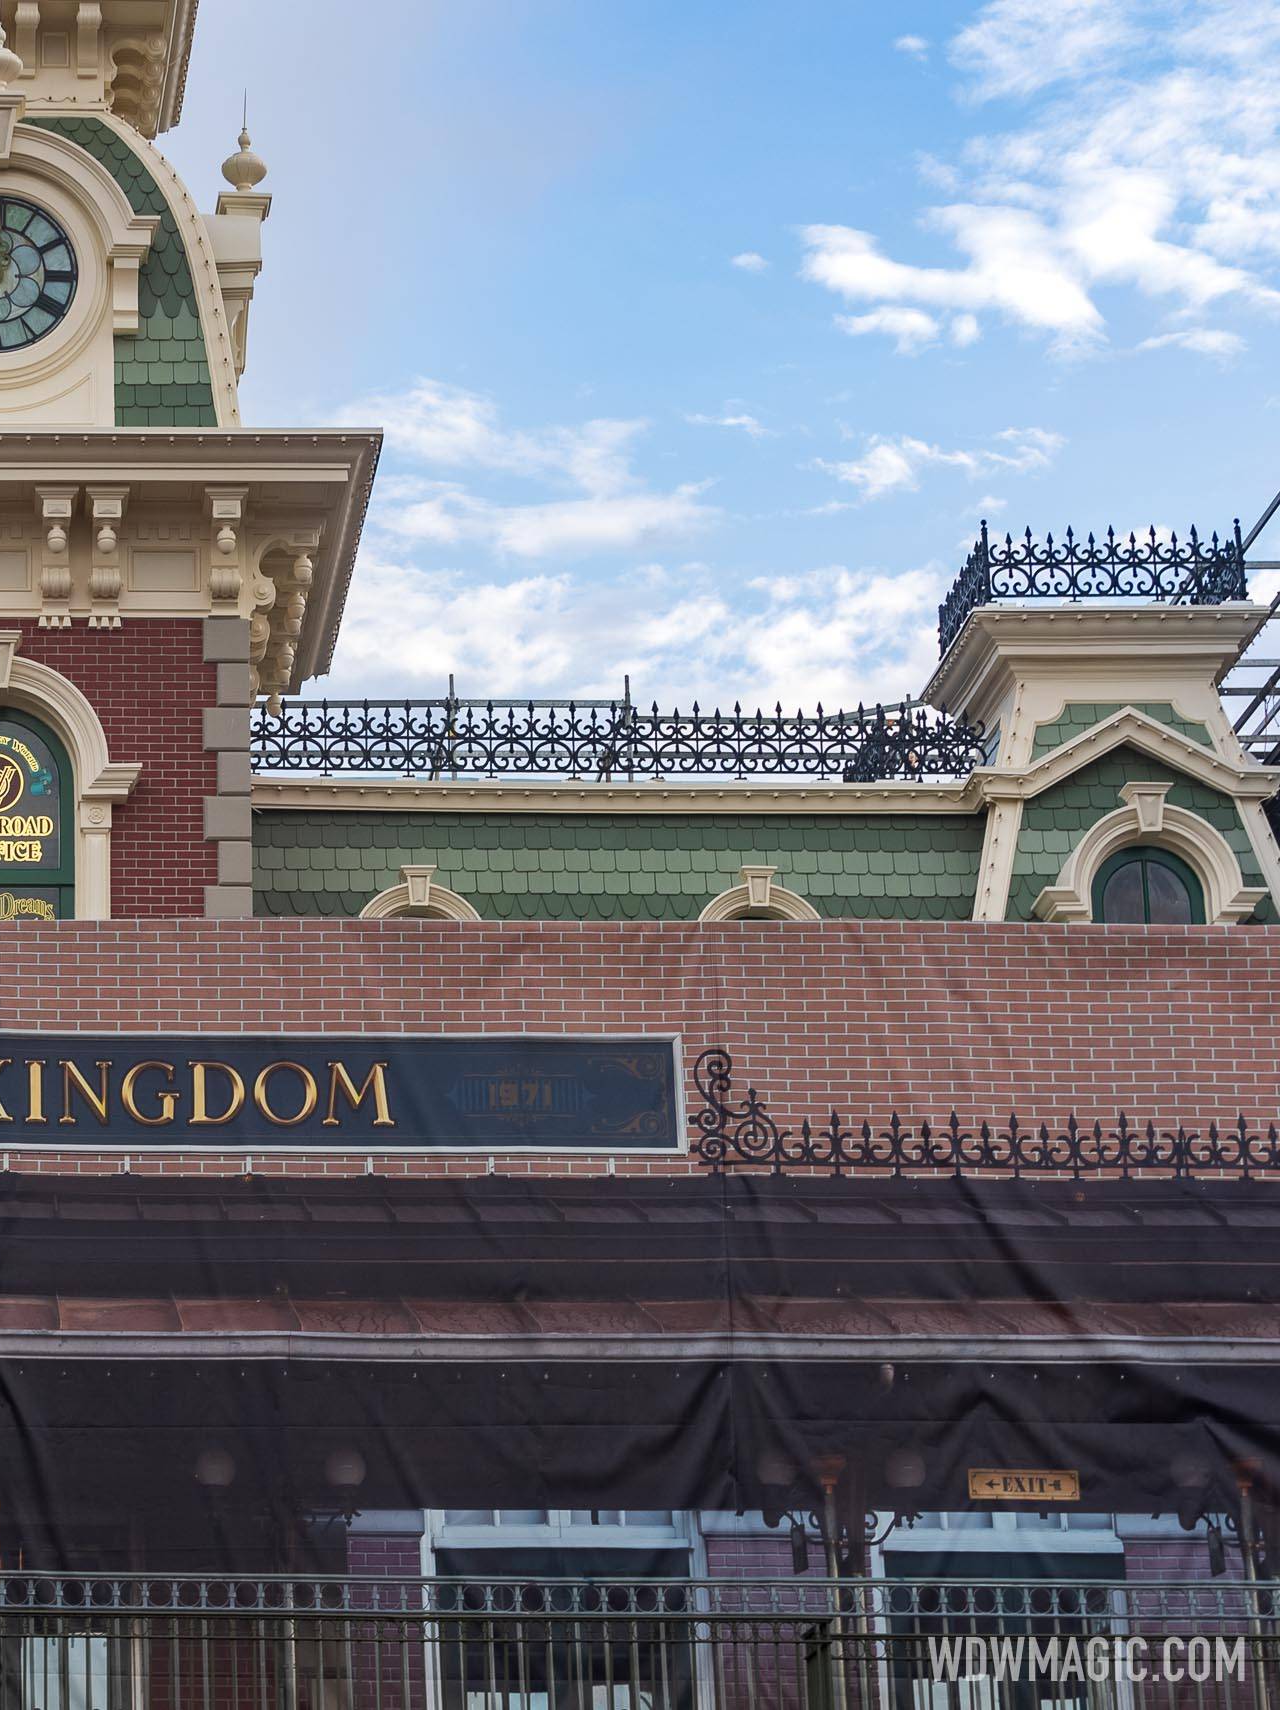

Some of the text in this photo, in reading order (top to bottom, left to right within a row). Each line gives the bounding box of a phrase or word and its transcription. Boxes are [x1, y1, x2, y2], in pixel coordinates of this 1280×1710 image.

[11, 738, 40, 773] WORLD
[487, 1080, 553, 1110] 1971
[1001, 1476, 1048, 1493] EXIT
